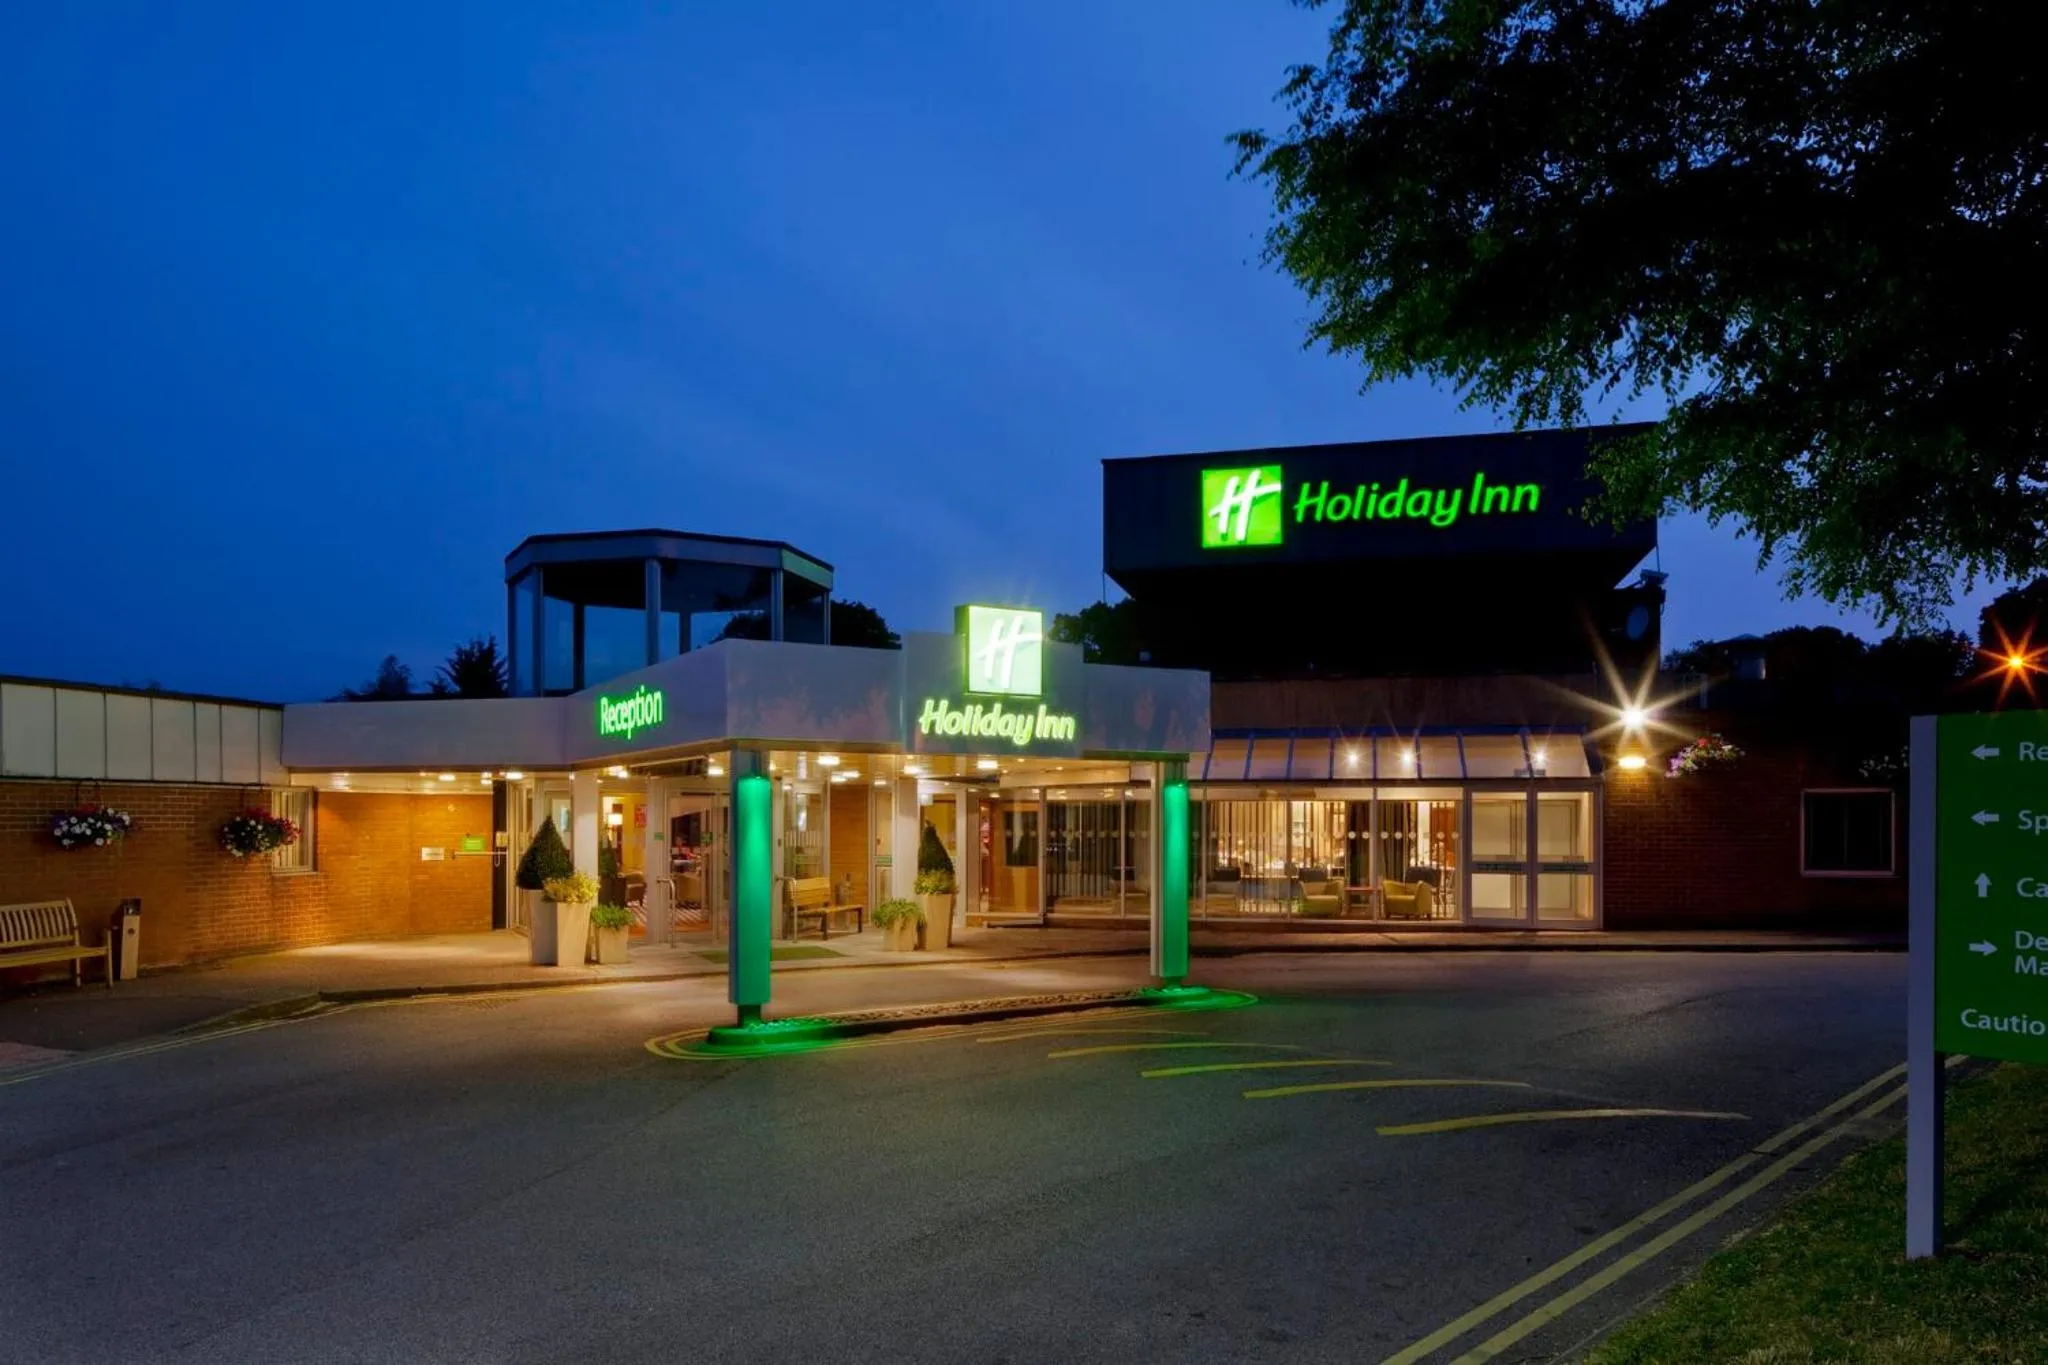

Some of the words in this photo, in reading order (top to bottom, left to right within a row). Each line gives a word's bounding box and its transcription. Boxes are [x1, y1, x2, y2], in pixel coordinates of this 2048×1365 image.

[1293, 478, 1462, 527] Holiday
[1469, 472, 1540, 515] Inn
[600, 685, 662, 740] Reception
[919, 699, 1034, 745] Holiday
[1035, 704, 1075, 740] Inn
[1960, 1008, 2046, 1035] Cautio
